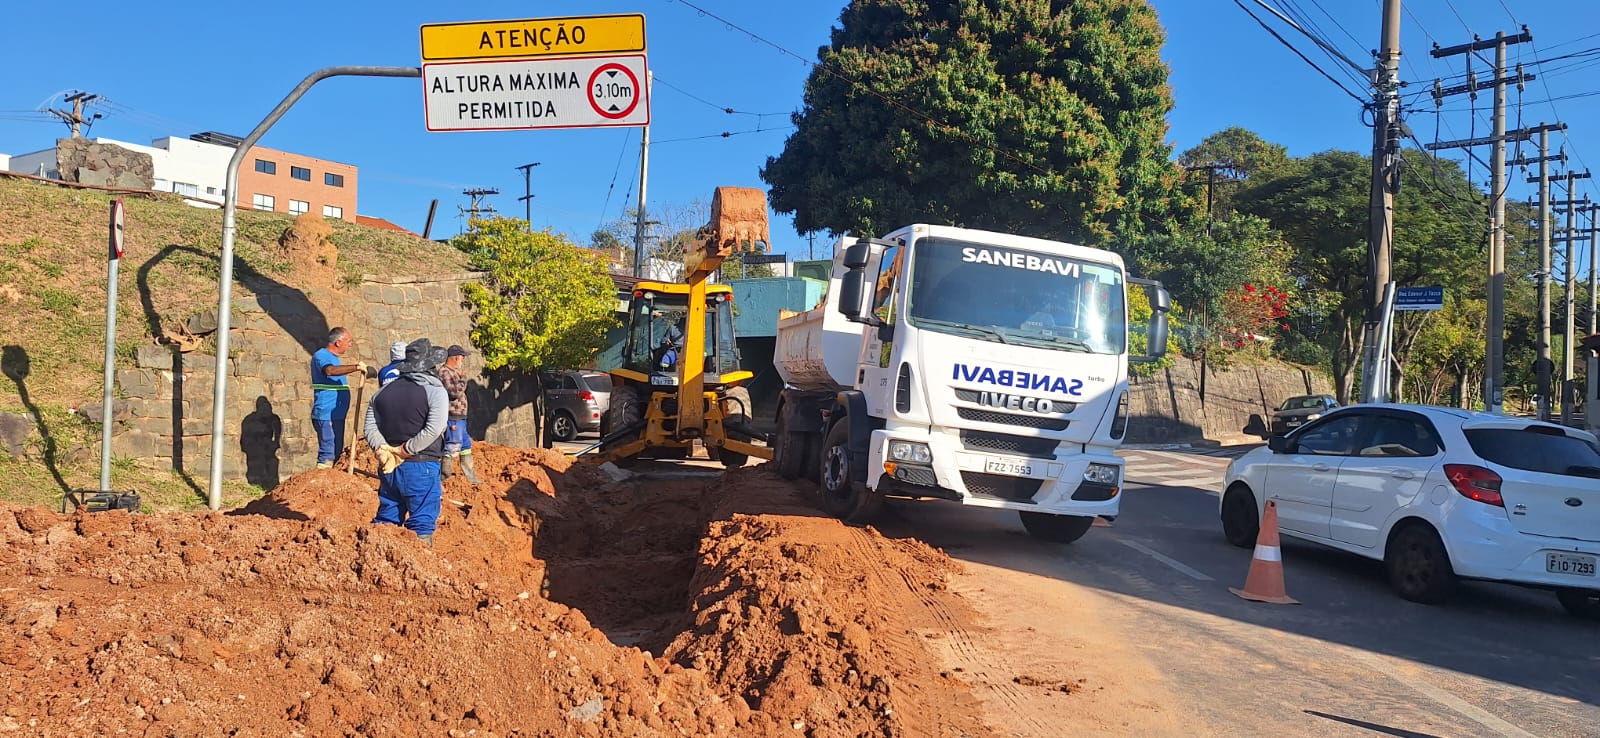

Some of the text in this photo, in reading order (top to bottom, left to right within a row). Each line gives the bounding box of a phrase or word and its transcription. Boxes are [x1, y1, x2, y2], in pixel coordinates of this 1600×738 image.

[478, 23, 586, 50] ATENÇÃO
[431, 70, 581, 94] ALTURA MÁXIMA
[458, 100, 557, 120] PERMITIDA
[962, 247, 1080, 278] SANEBAVI
[979, 391, 1054, 414] IVECO
[1571, 562, 1595, 574] 7293
